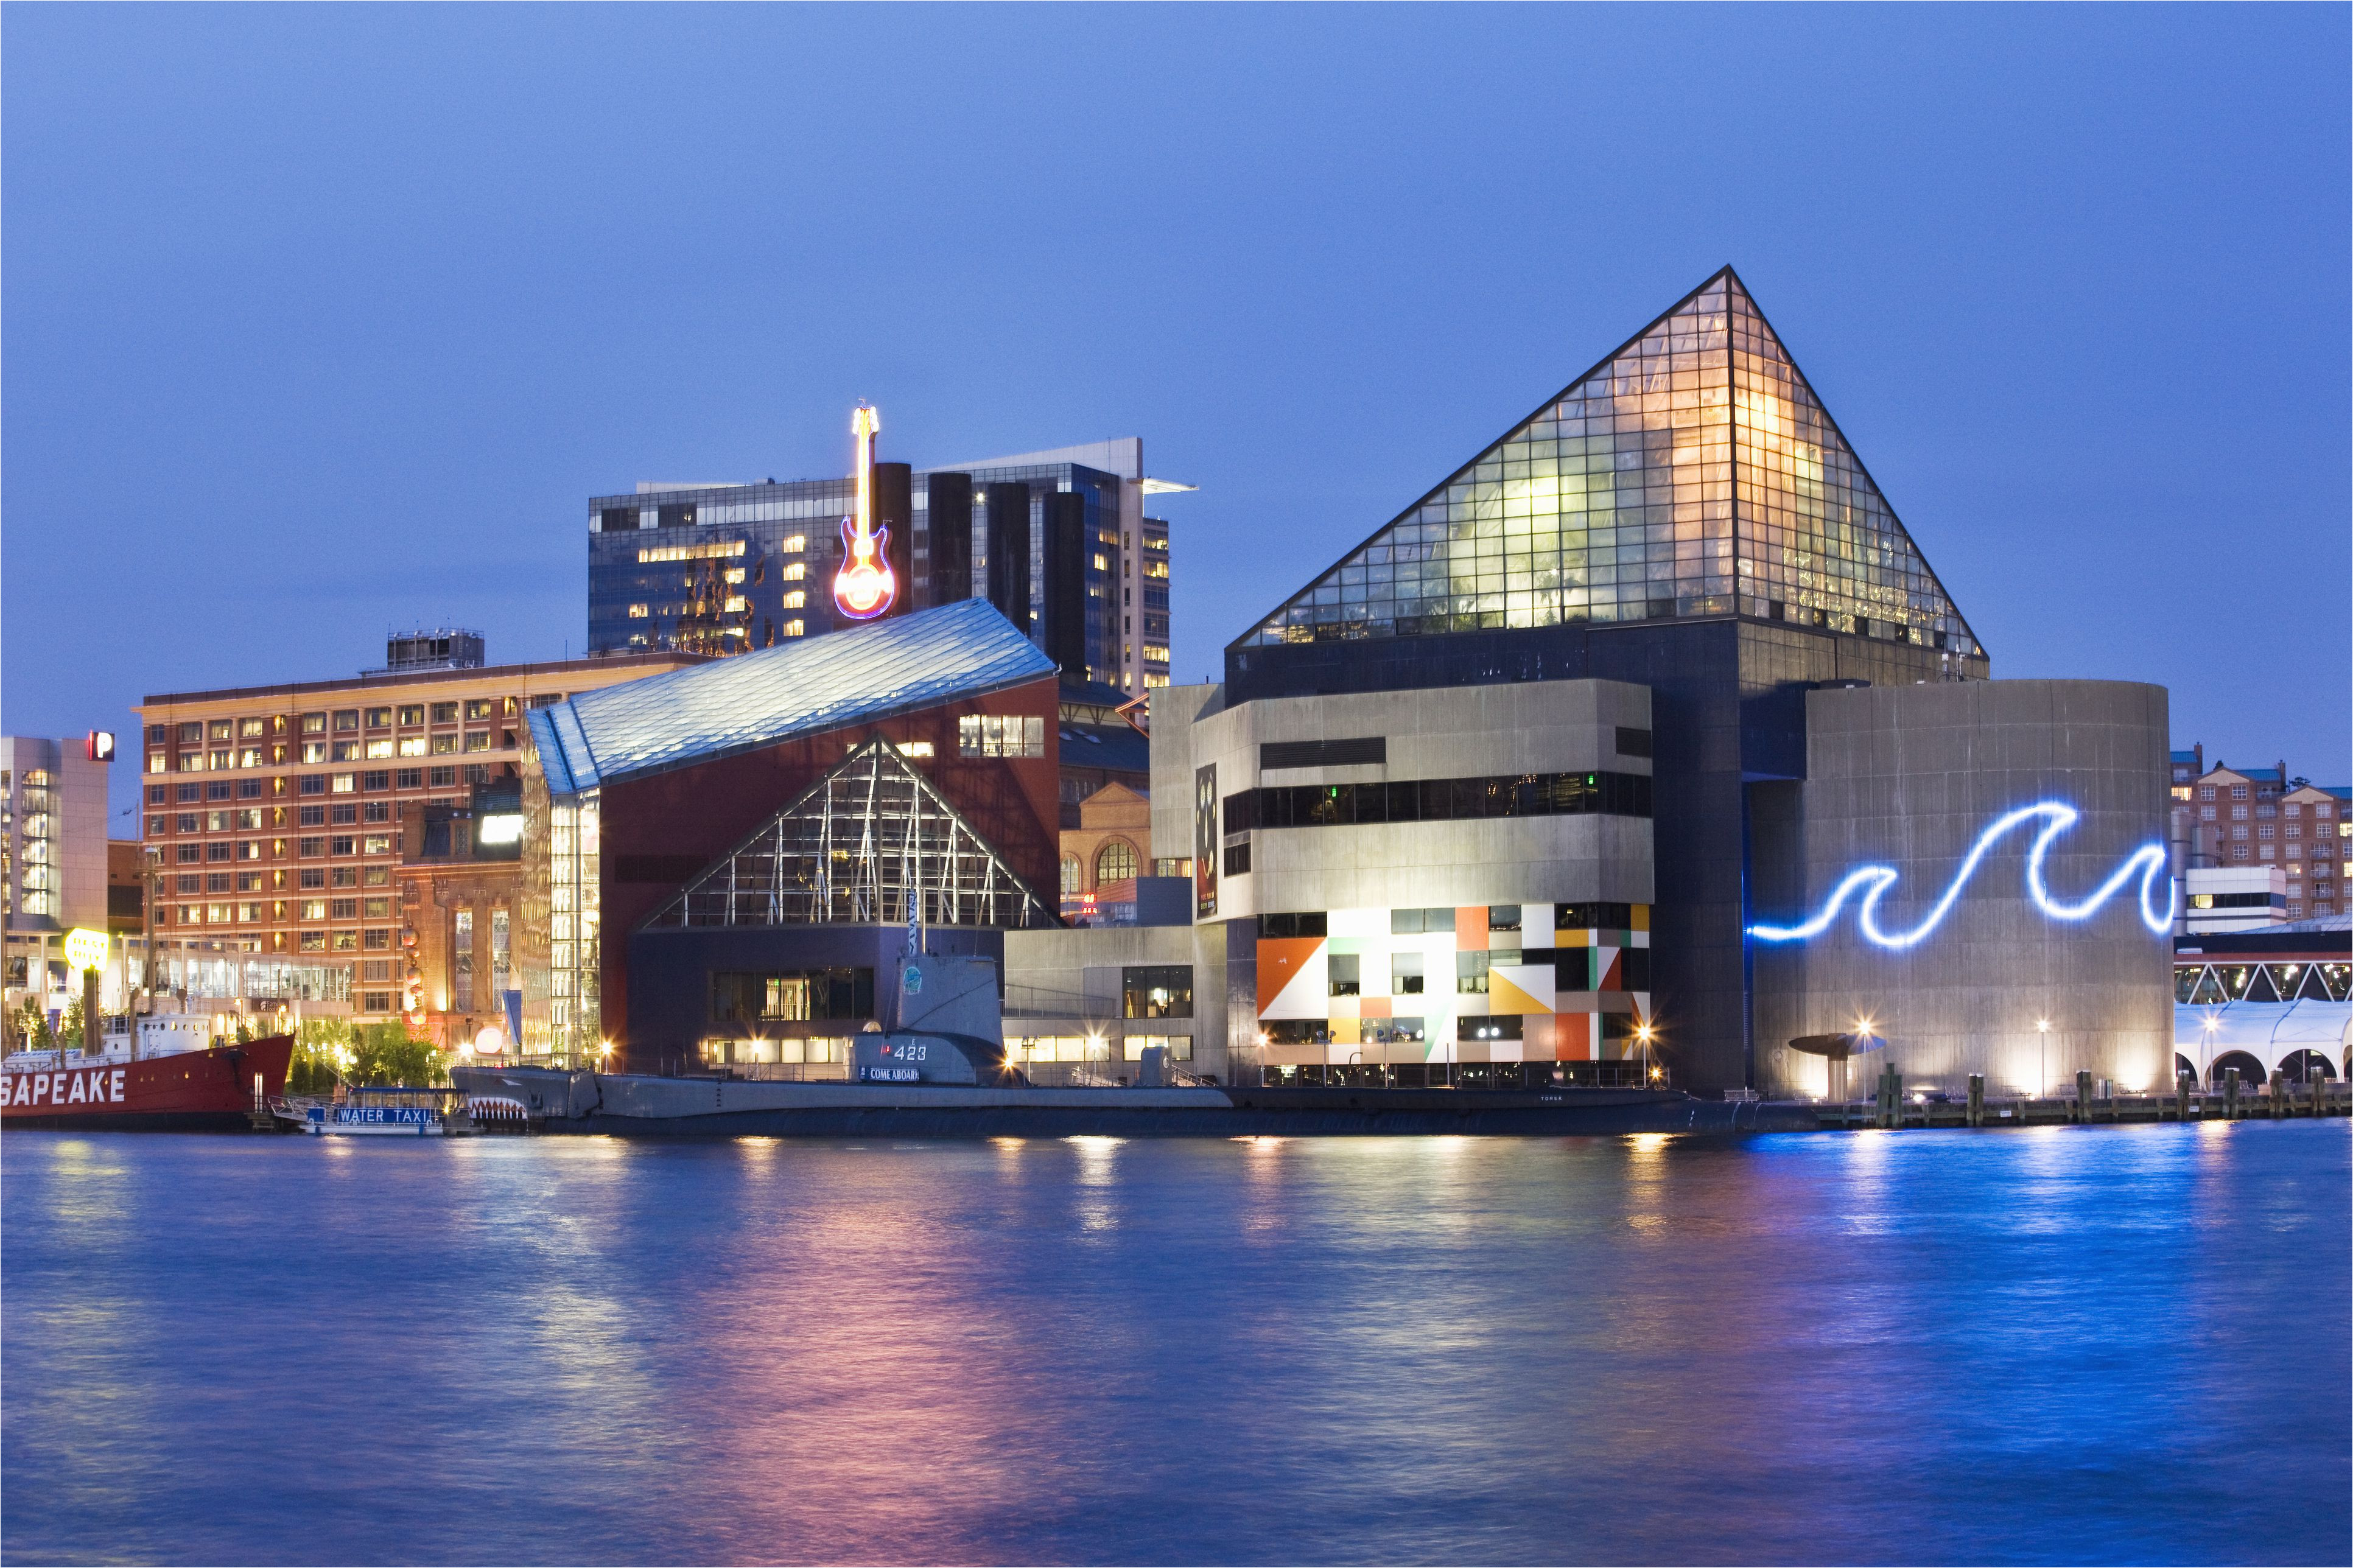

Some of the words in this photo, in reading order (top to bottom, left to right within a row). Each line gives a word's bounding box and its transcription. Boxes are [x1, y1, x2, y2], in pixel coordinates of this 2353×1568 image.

[894, 1045, 926, 1061] 423
[871, 1069, 891, 1079] COME
[1, 1070, 125, 1107] SAPEAKE
[340, 1110, 384, 1122] WATER
[394, 1110, 426, 1122] TAXI
